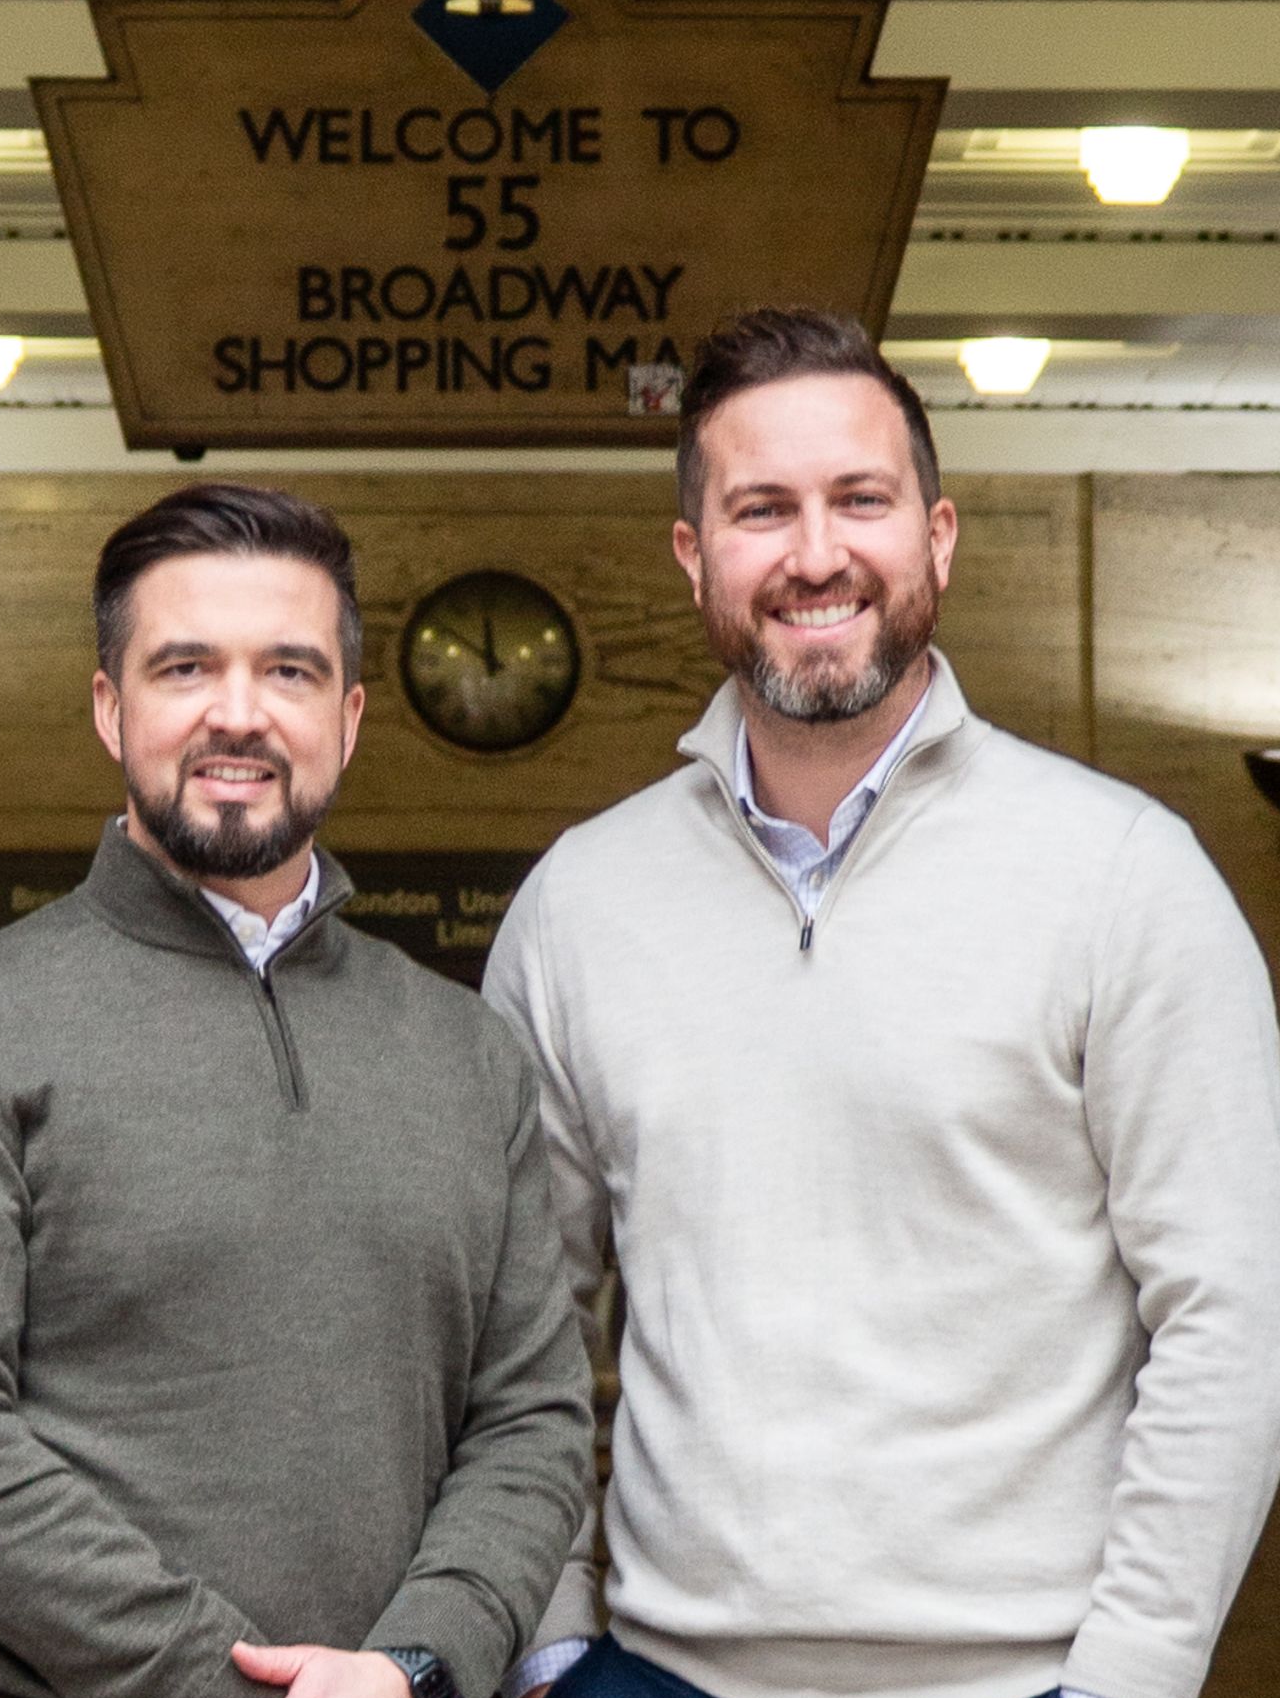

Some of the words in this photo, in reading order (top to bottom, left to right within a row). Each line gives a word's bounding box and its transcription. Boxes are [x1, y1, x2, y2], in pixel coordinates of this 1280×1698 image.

[238, 105, 602, 164] WELCOME
[642, 106, 741, 164] TO
[442, 174, 541, 252] 55
[298, 263, 685, 322] BROADWAY
[214, 335, 552, 395] SHOPPING
[344, 887, 439, 915] ondon
